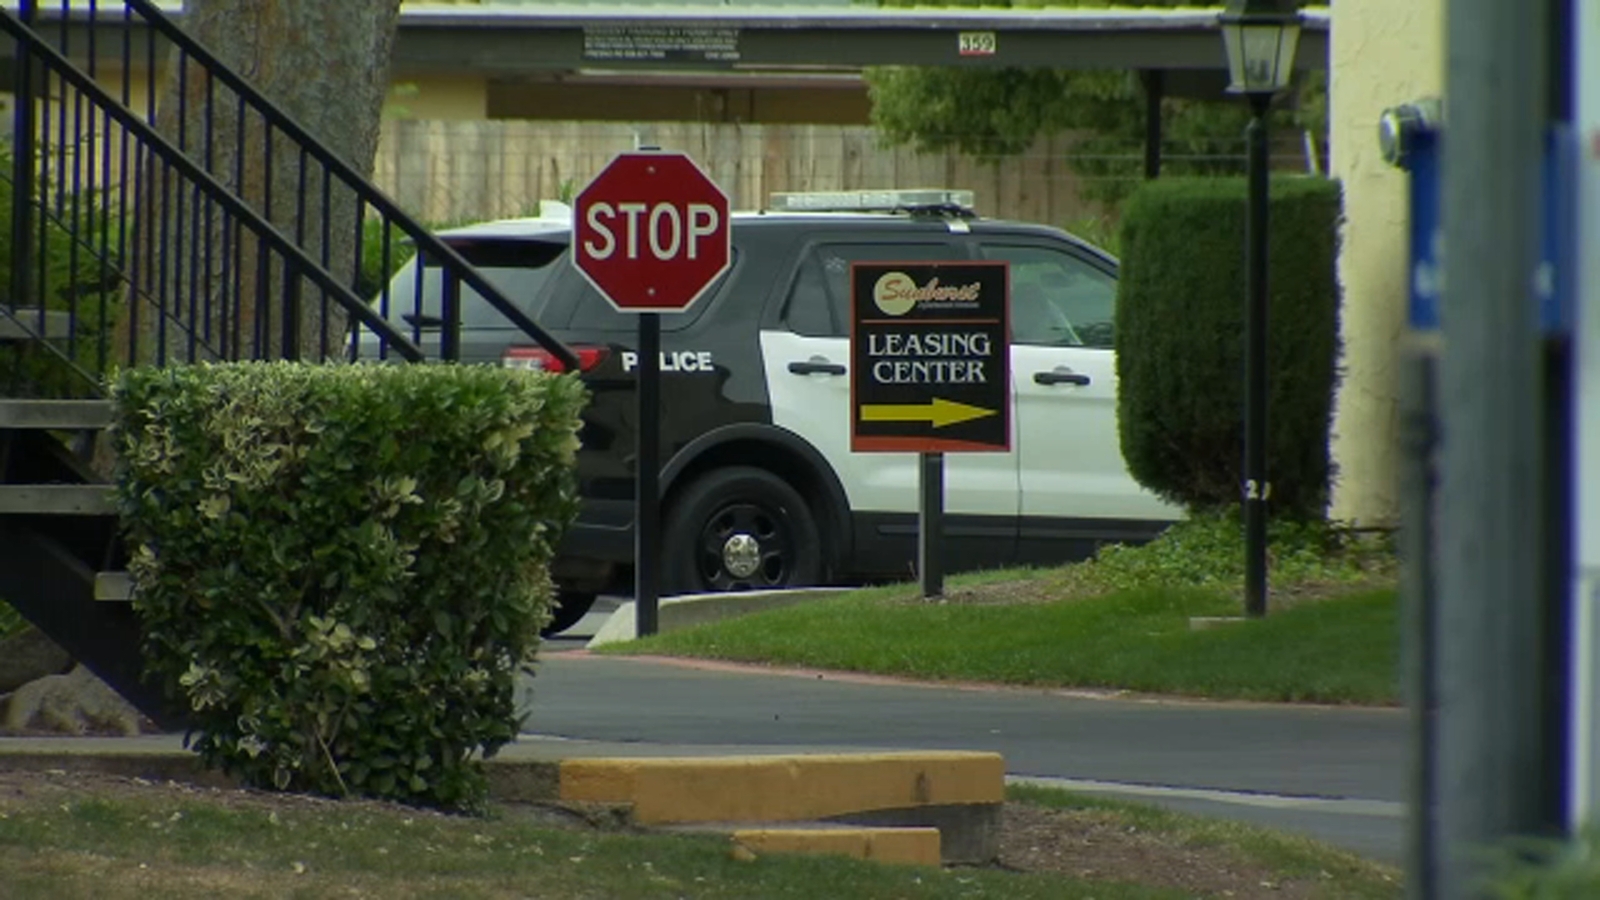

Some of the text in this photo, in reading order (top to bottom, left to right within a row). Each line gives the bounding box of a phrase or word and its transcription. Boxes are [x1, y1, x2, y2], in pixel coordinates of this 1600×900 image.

[584, 202, 719, 260] STOP
[881, 277, 981, 301] Sunburst
[868, 333, 992, 356] LEASING
[621, 351, 715, 372] PLICE
[873, 361, 988, 383] CENTER
